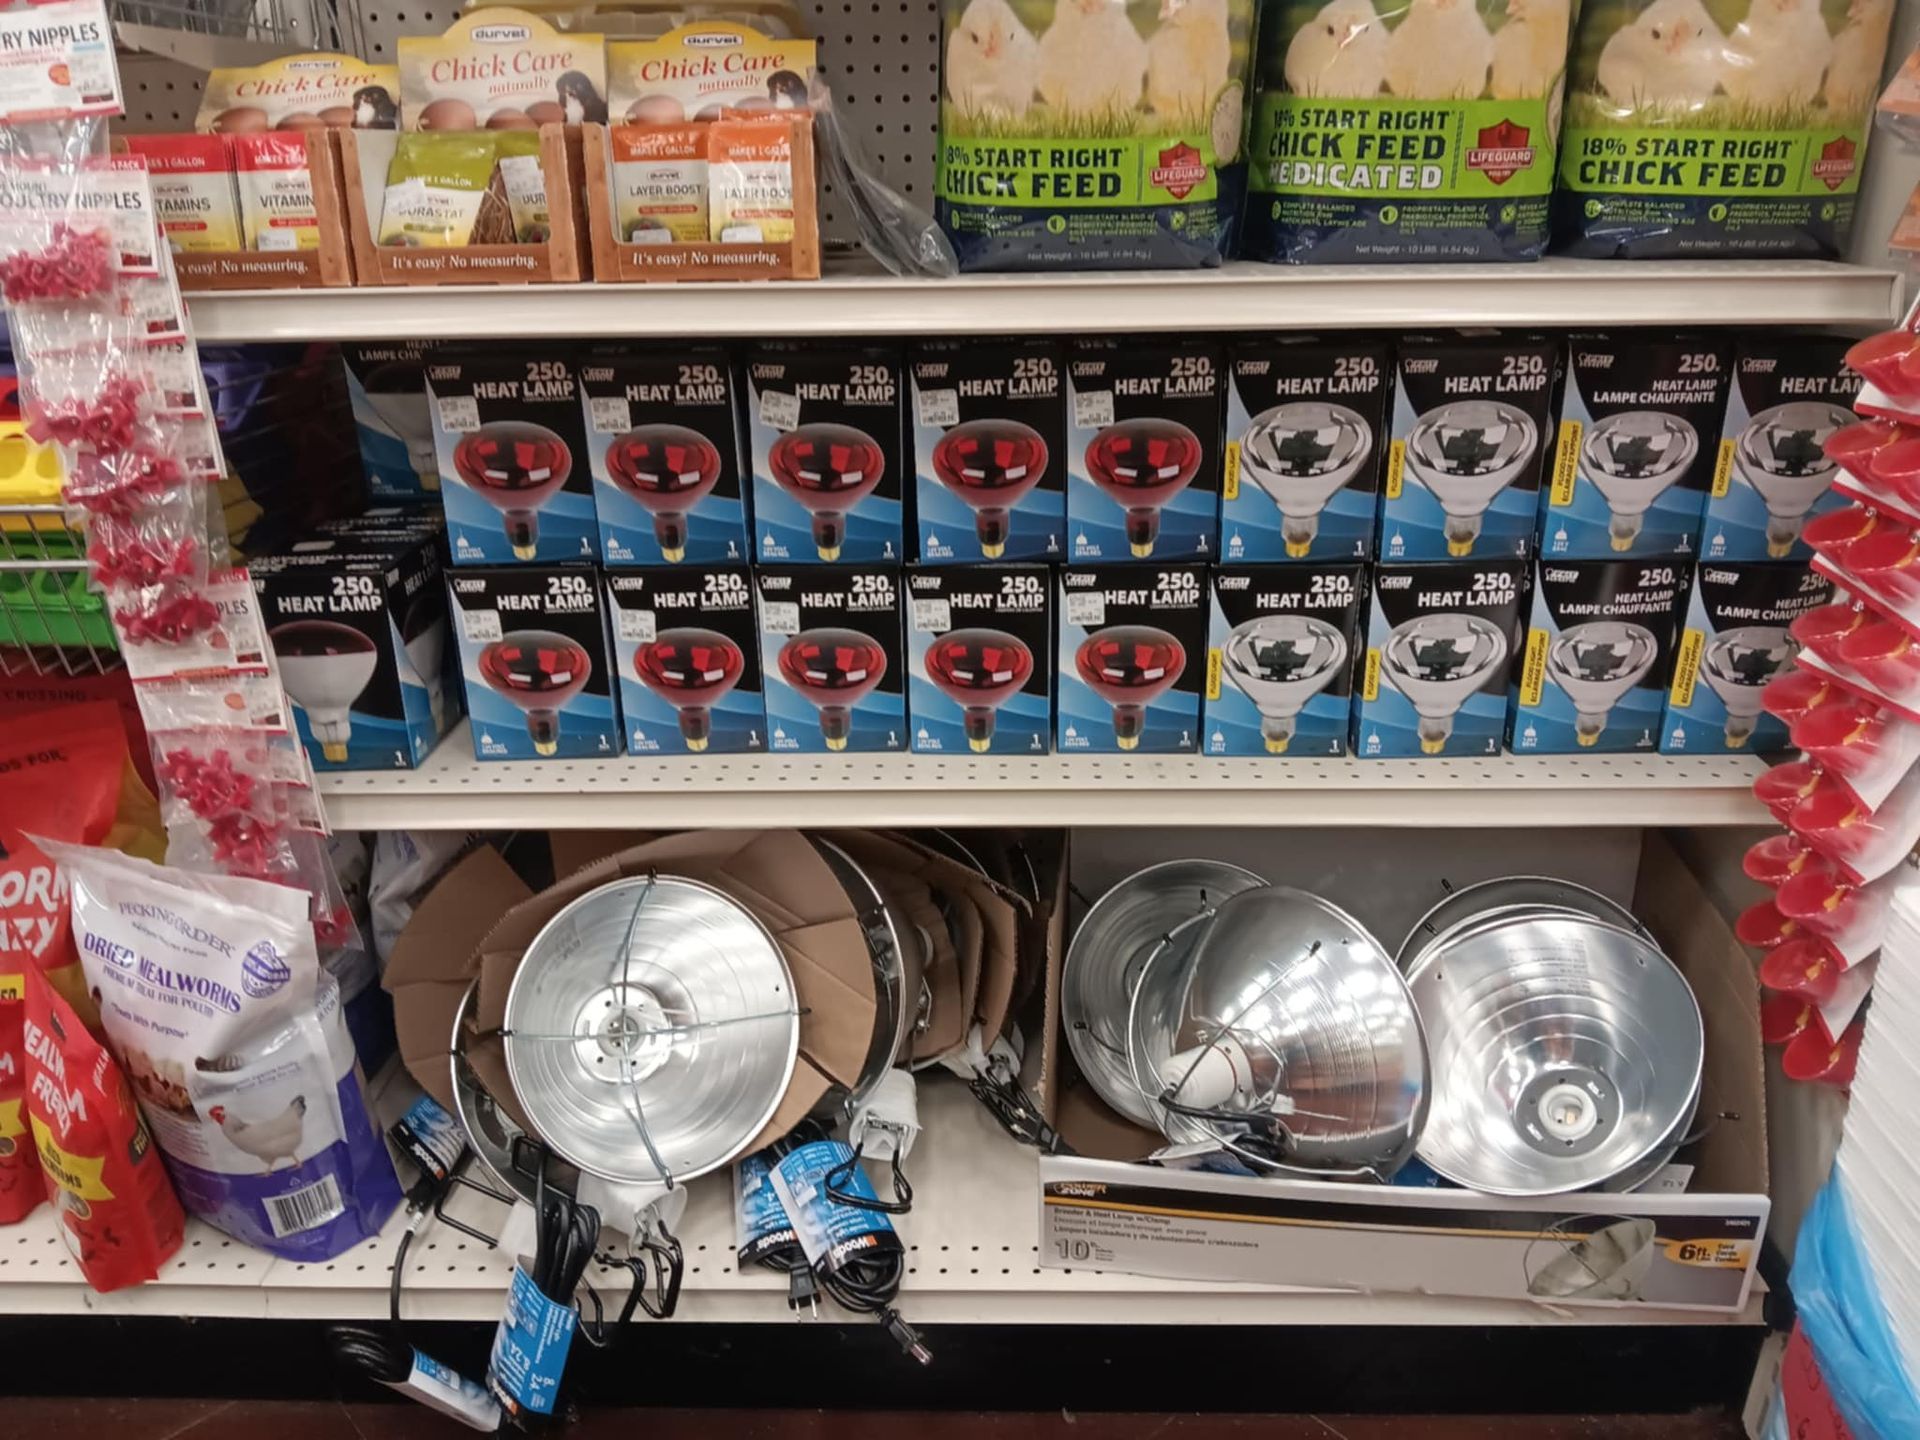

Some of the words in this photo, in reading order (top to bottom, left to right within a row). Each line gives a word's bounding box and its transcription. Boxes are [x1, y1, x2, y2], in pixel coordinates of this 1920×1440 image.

[28, 22, 100, 47] NIPPLES
[475, 29, 527, 40] durvet
[687, 36, 738, 45] durvet
[289, 60, 341, 69] durvet
[432, 55, 506, 84] Chick
[513, 50, 573, 74] Care
[641, 57, 717, 82] Chick
[723, 53, 785, 73] Care
[236, 77, 309, 97] Chick
[315, 71, 376, 88] Care
[488, 78, 550, 94] naturally
[698, 75, 762, 93] naturally
[1301, 109, 1370, 129] START
[1378, 110, 1451, 130] RIGHT
[1269, 132, 1344, 158] CHICK
[1356, 134, 1446, 160] FEED
[1582, 137, 1627, 157] 18%
[1635, 138, 1713, 158] START
[1722, 139, 1792, 159] RIGHT
[170, 157, 206, 168] GALLON
[974, 148, 1042, 168] START
[1050, 148, 1123, 168] RIGHT
[1470, 151, 1532, 163] LIFEGUARD
[1153, 168, 1206, 181] LIFEGUARD
[1269, 161, 1443, 189] MEDICATED
[1579, 160, 1687, 185] CHICK
[1698, 162, 1787, 187] FEED
[630, 184, 663, 197] LAYER
[666, 184, 701, 195] BOOST
[946, 169, 1019, 197] CHICK
[1032, 172, 1122, 198] FEED
[75, 192, 142, 210] NIPPLES
[187, 259, 218, 276] easy!
[221, 259, 239, 272] No
[242, 259, 308, 275] measuring.
[392, 256, 412, 269] It's
[415, 256, 446, 272] easy!
[450, 256, 467, 268] No
[471, 255, 538, 271] measuring.
[633, 252, 653, 265] It's
[656, 252, 687, 268] easy!
[691, 252, 708, 264] No
[712, 252, 780, 266] measuring.
[359, 350, 396, 361] LAMPE
[473, 382, 518, 398] HEAT
[523, 381, 574, 397] LAMP
[626, 384, 670, 401] HEAT
[676, 383, 725, 400] LAMP
[796, 383, 840, 401] HEAT
[845, 384, 895, 401] LAMP
[959, 380, 1004, 397] HEAT
[1008, 377, 1058, 395] LAMP
[1115, 378, 1160, 395] HEAT
[1165, 376, 1215, 394] LAMP
[1277, 377, 1324, 395] HEAT
[1328, 376, 1379, 393] LAMP
[1445, 376, 1492, 394] HEAT
[1496, 375, 1547, 393] LAMP
[1653, 380, 1682, 391] HEAT
[1685, 379, 1717, 391] LAMP
[1781, 377, 1828, 394] HEAT
[1593, 391, 1636, 404] LAMPE
[1640, 391, 1715, 404] CHAUFFANTE
[278, 597, 325, 613] HEAT
[329, 595, 383, 612] LAMP
[497, 595, 541, 611] HEAT
[545, 593, 594, 609] LAMP
[654, 592, 698, 608] HEAT
[701, 591, 749, 607] LAMP
[801, 592, 844, 608] HEAT
[848, 592, 895, 607] LAMP
[950, 593, 994, 608] HEAT
[997, 593, 1044, 608] LAMP
[1105, 590, 1148, 605] HEAT
[1151, 589, 1199, 605] LAMP
[1256, 593, 1301, 609] HEAT
[1305, 593, 1354, 609] LAMP
[1418, 592, 1463, 607] HEAT
[1466, 590, 1515, 606] LAMP
[1615, 592, 1645, 604] HEAT
[1648, 590, 1674, 602] LAMP
[1776, 599, 1801, 610] HEAT
[1803, 594, 1826, 606] LAMP
[1560, 603, 1600, 615] LAMPE
[1602, 602, 1672, 615] CHAUFFANTE
[1717, 605, 1760, 620] LAMPE
[174, 915, 232, 959] ORDER
[84, 932, 135, 969] DRIED
[138, 955, 241, 1014] MEALWORMS
[157, 992, 178, 1005] FOR
[1093, 1211, 1111, 1219] Heat
[1113, 1212, 1134, 1221] Lamp
[756, 1229, 794, 1251] Woods
[832, 1235, 869, 1259] Woods
[1055, 1238, 1090, 1261] 10
